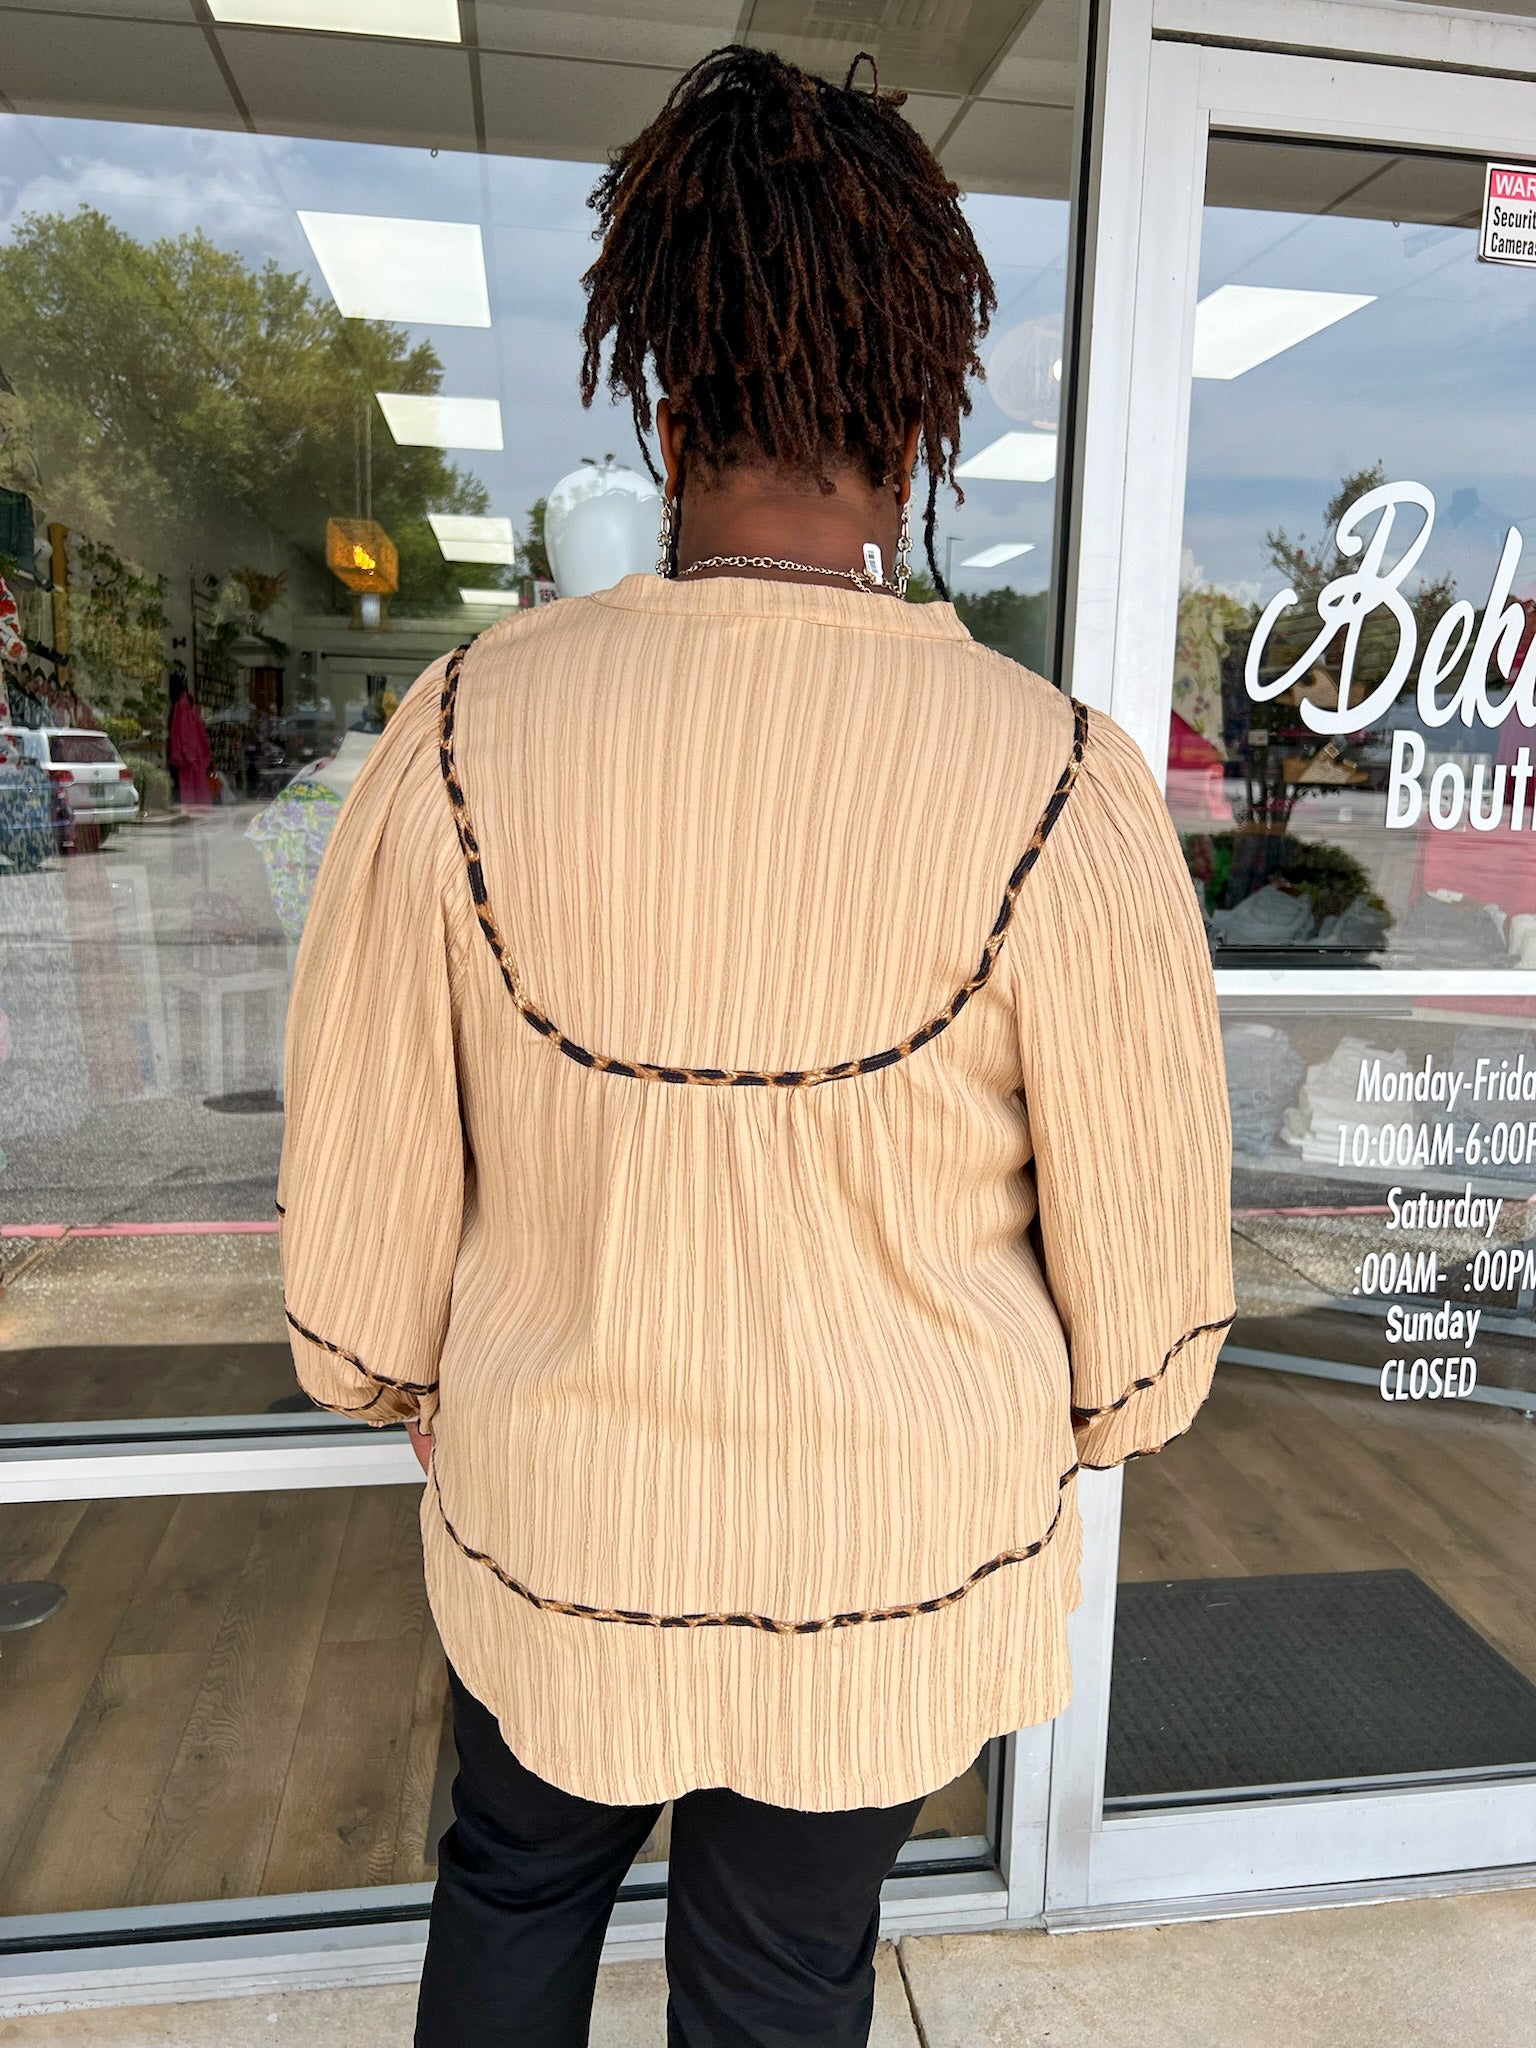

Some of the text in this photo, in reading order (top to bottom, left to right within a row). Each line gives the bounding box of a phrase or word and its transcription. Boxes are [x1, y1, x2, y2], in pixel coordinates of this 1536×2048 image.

[1491, 232, 1536, 255] Camera
[1386, 730, 1536, 831] Bout
[1386, 1182, 1503, 1238] Saturday
[1385, 1300, 1481, 1349] Sunday
[1380, 1357, 1477, 1401] CLOSED
